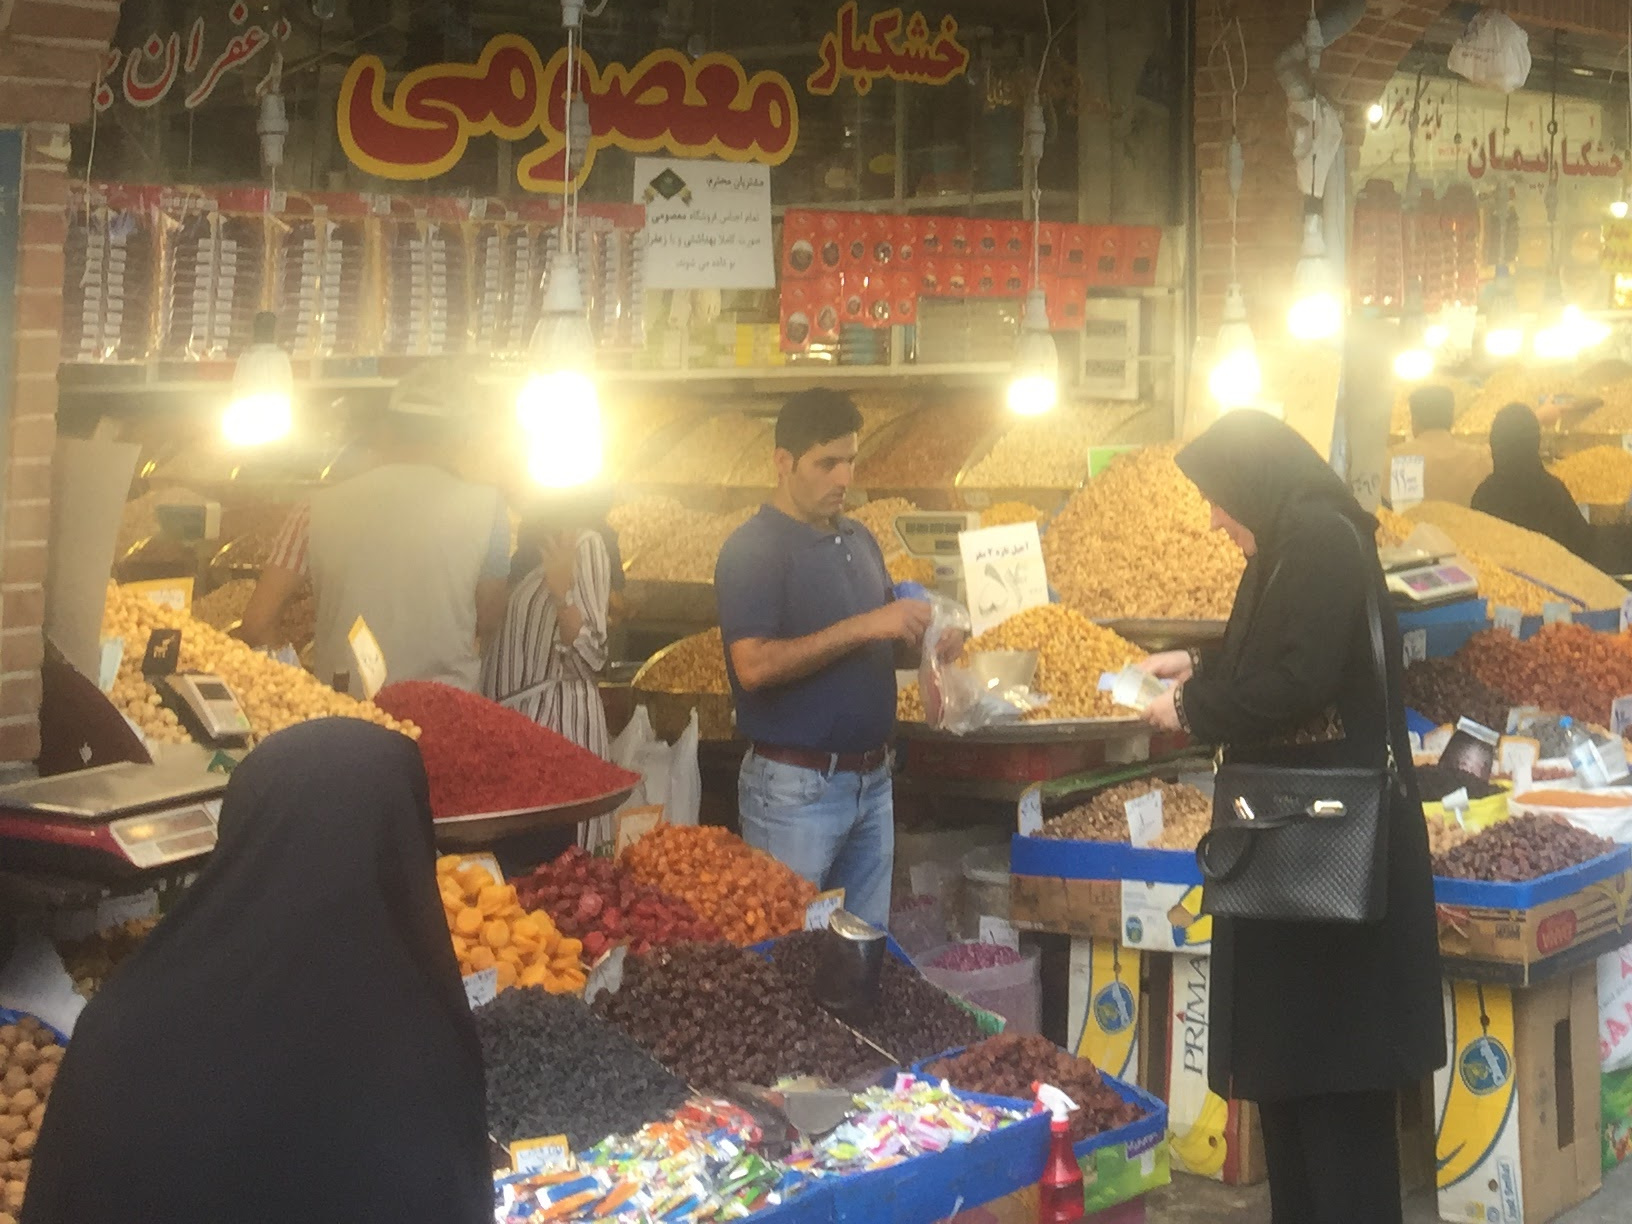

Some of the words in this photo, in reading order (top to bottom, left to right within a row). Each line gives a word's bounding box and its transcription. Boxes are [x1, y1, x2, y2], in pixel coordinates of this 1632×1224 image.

[807, 0, 970, 96] خشکبار
[336, 32, 799, 193] معصومی
[1183, 954, 1209, 1077] PRIMA
